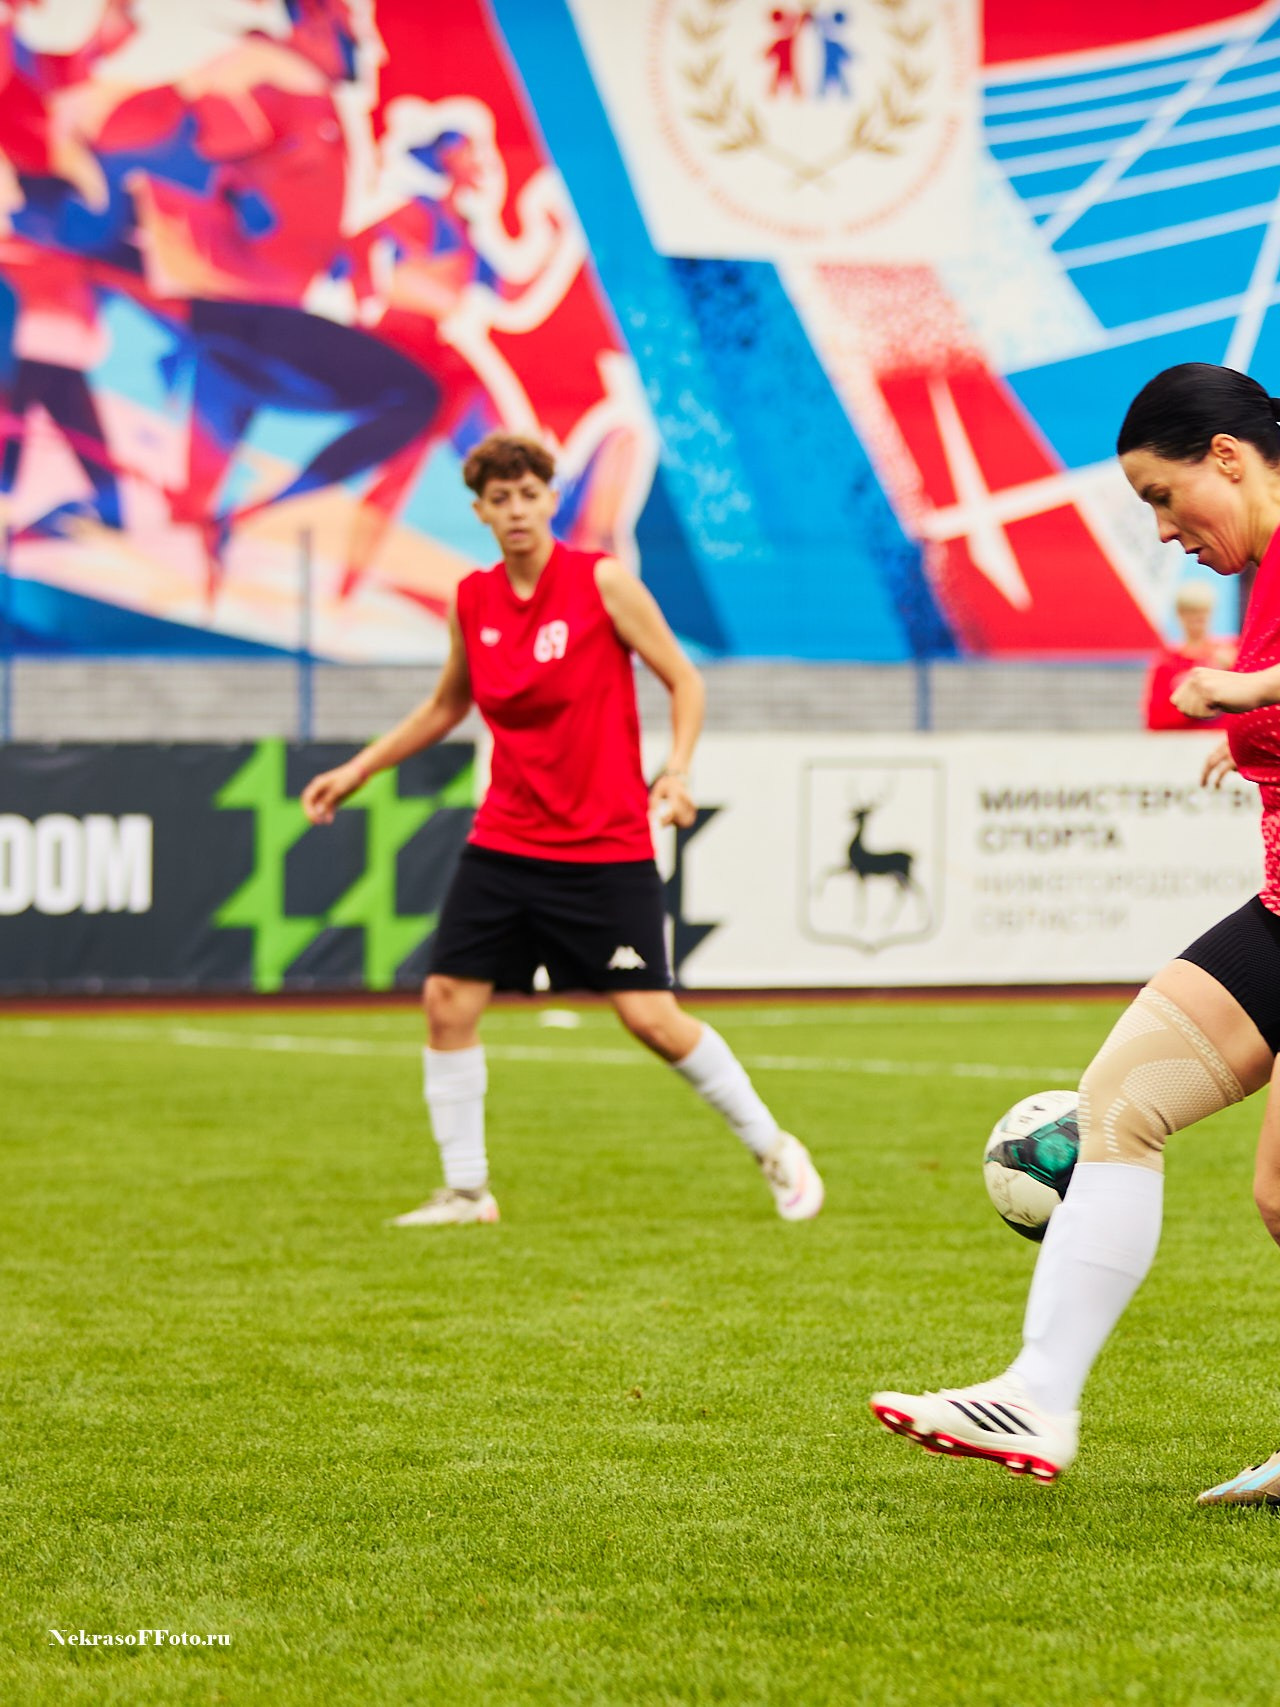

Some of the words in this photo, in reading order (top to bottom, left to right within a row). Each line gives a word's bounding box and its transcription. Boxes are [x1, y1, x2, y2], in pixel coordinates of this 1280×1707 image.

[533, 619, 569, 663] 69
[978, 786, 1260, 814] МИНИСТЕРСТВ
[978, 824, 1124, 852] СПОРТА
